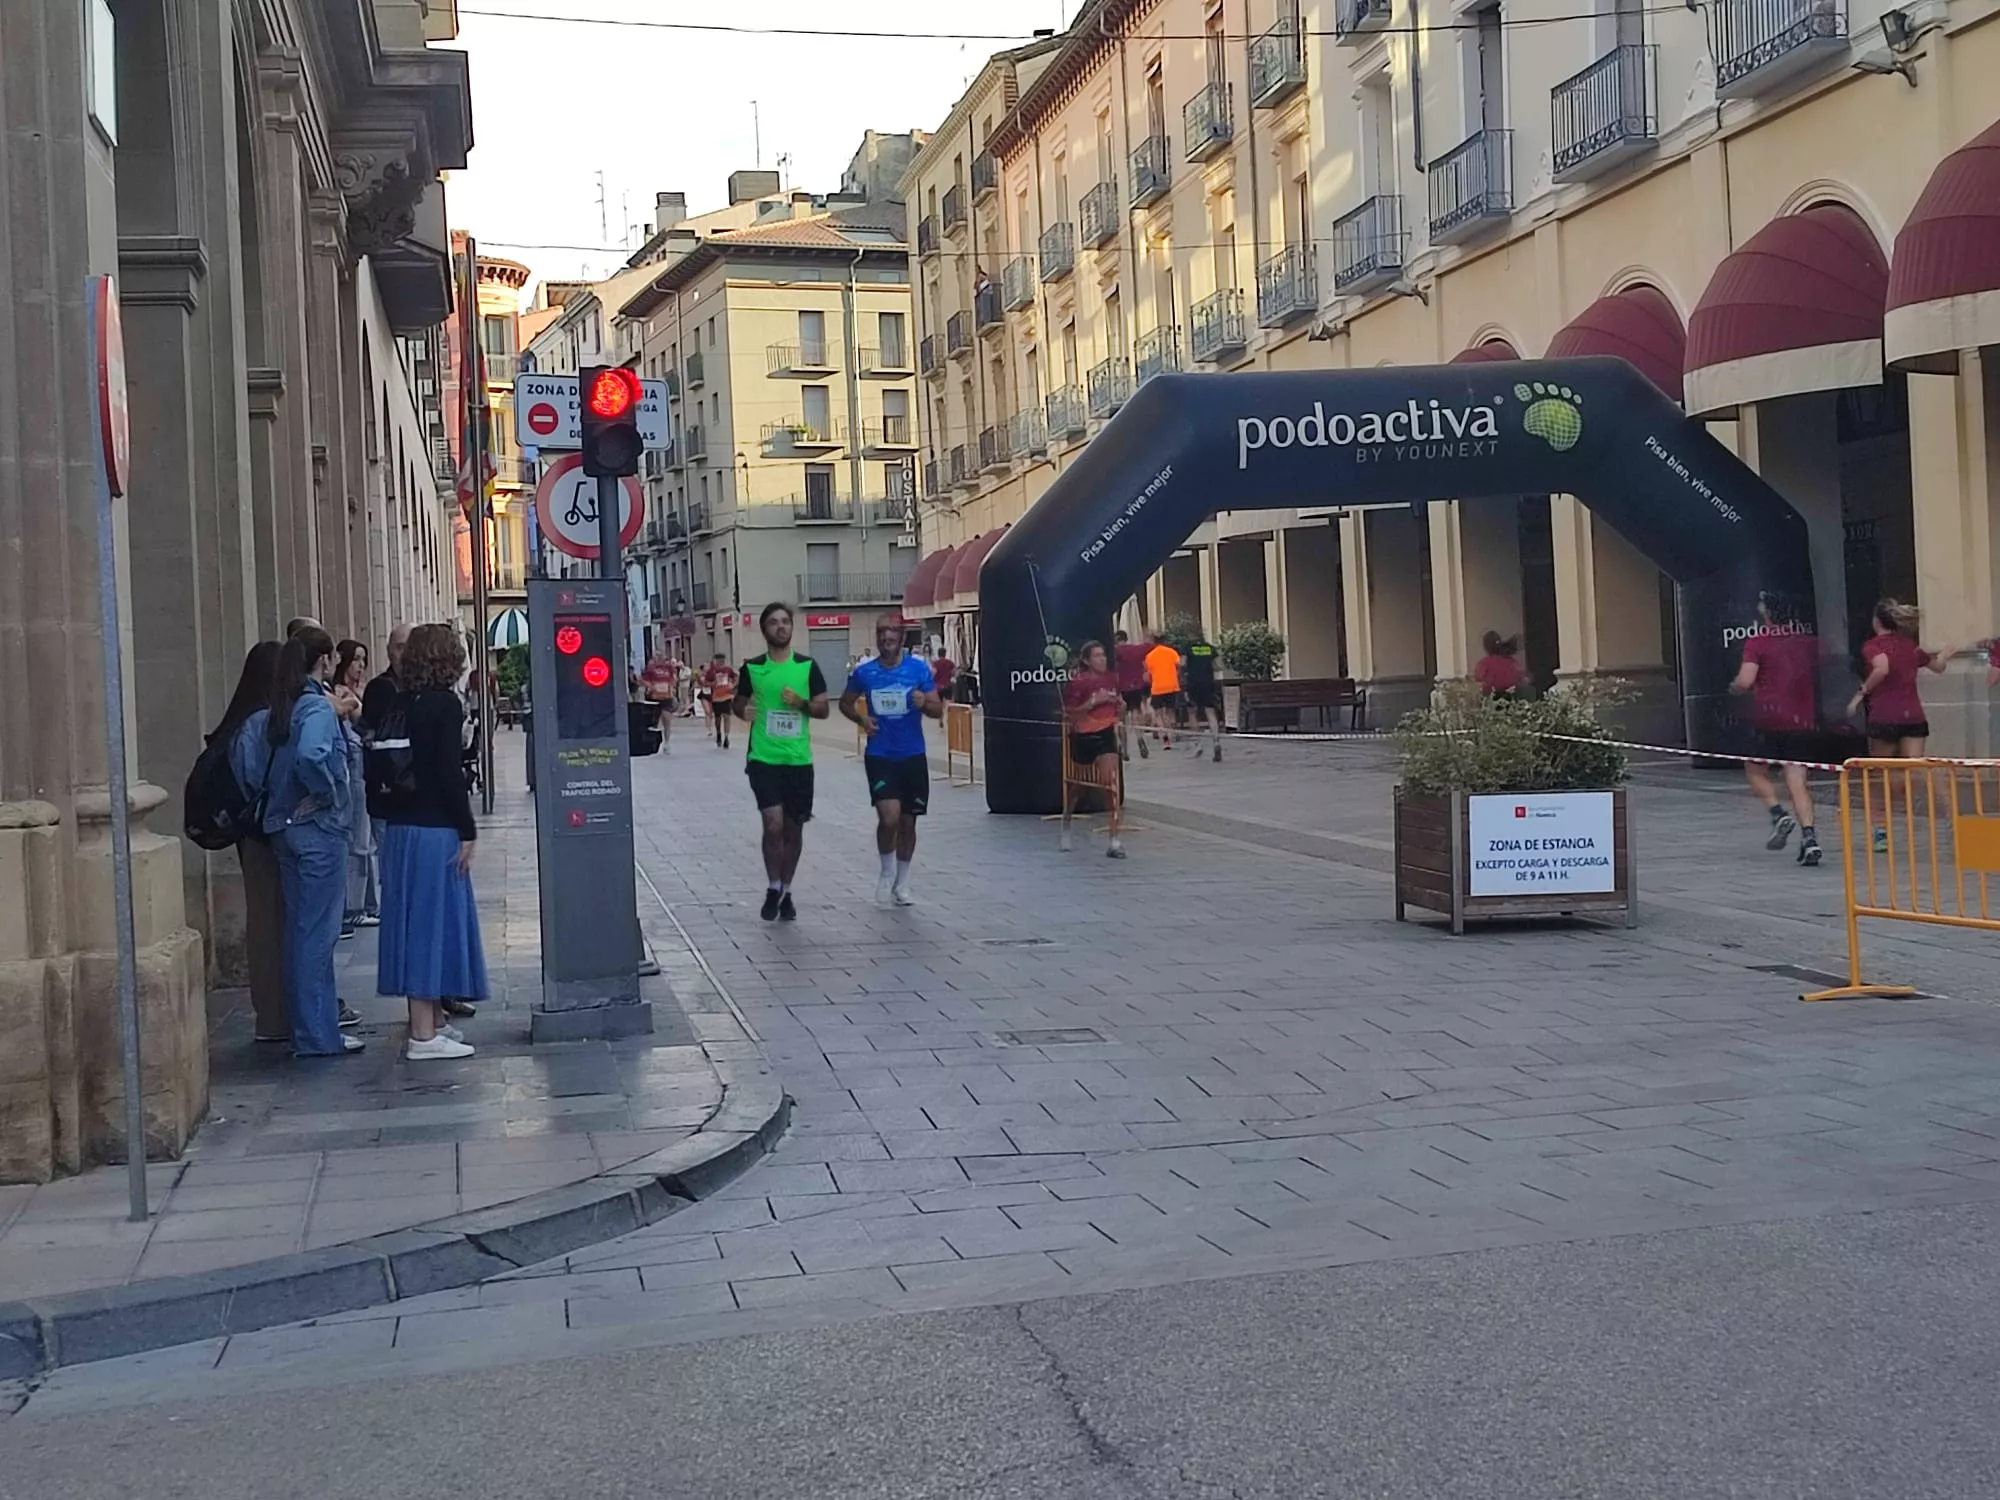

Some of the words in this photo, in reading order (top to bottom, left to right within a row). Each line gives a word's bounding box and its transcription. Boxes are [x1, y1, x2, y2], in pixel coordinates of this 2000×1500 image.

[527, 384, 565, 396] ZONA
[1237, 399, 1499, 470] podoactiva
[1355, 447, 1383, 464] BY
[1395, 440, 1499, 461] YOUNEXT
[1644, 435, 1668, 460] Pisa
[1666, 454, 1690, 483] bien,
[1691, 477, 1712, 498] vive
[1710, 495, 1742, 523] mejor
[902, 456, 915, 532] HOSTAL
[1080, 539, 1106, 563] Pisa
[1101, 516, 1130, 542] bien,
[1125, 495, 1147, 516] vive
[1144, 464, 1174, 497] mejor
[817, 616, 839, 625] GAES
[1010, 663, 1076, 692] podoac
[1489, 840, 1521, 851] ZONA
[1525, 839, 1538, 850] DE
[1542, 838, 1595, 850] ESTANCIA
[1475, 859, 1516, 870] EXCEPTO
[1518, 859, 1549, 868] CARGA
[1552, 858, 1558, 867] Y
[1561, 857, 1609, 867] DESCARGA
[1516, 871, 1528, 881] DE
[1530, 871, 1536, 881] 9
[1538, 871, 1545, 880] A
[1548, 870, 1557, 880] 11
